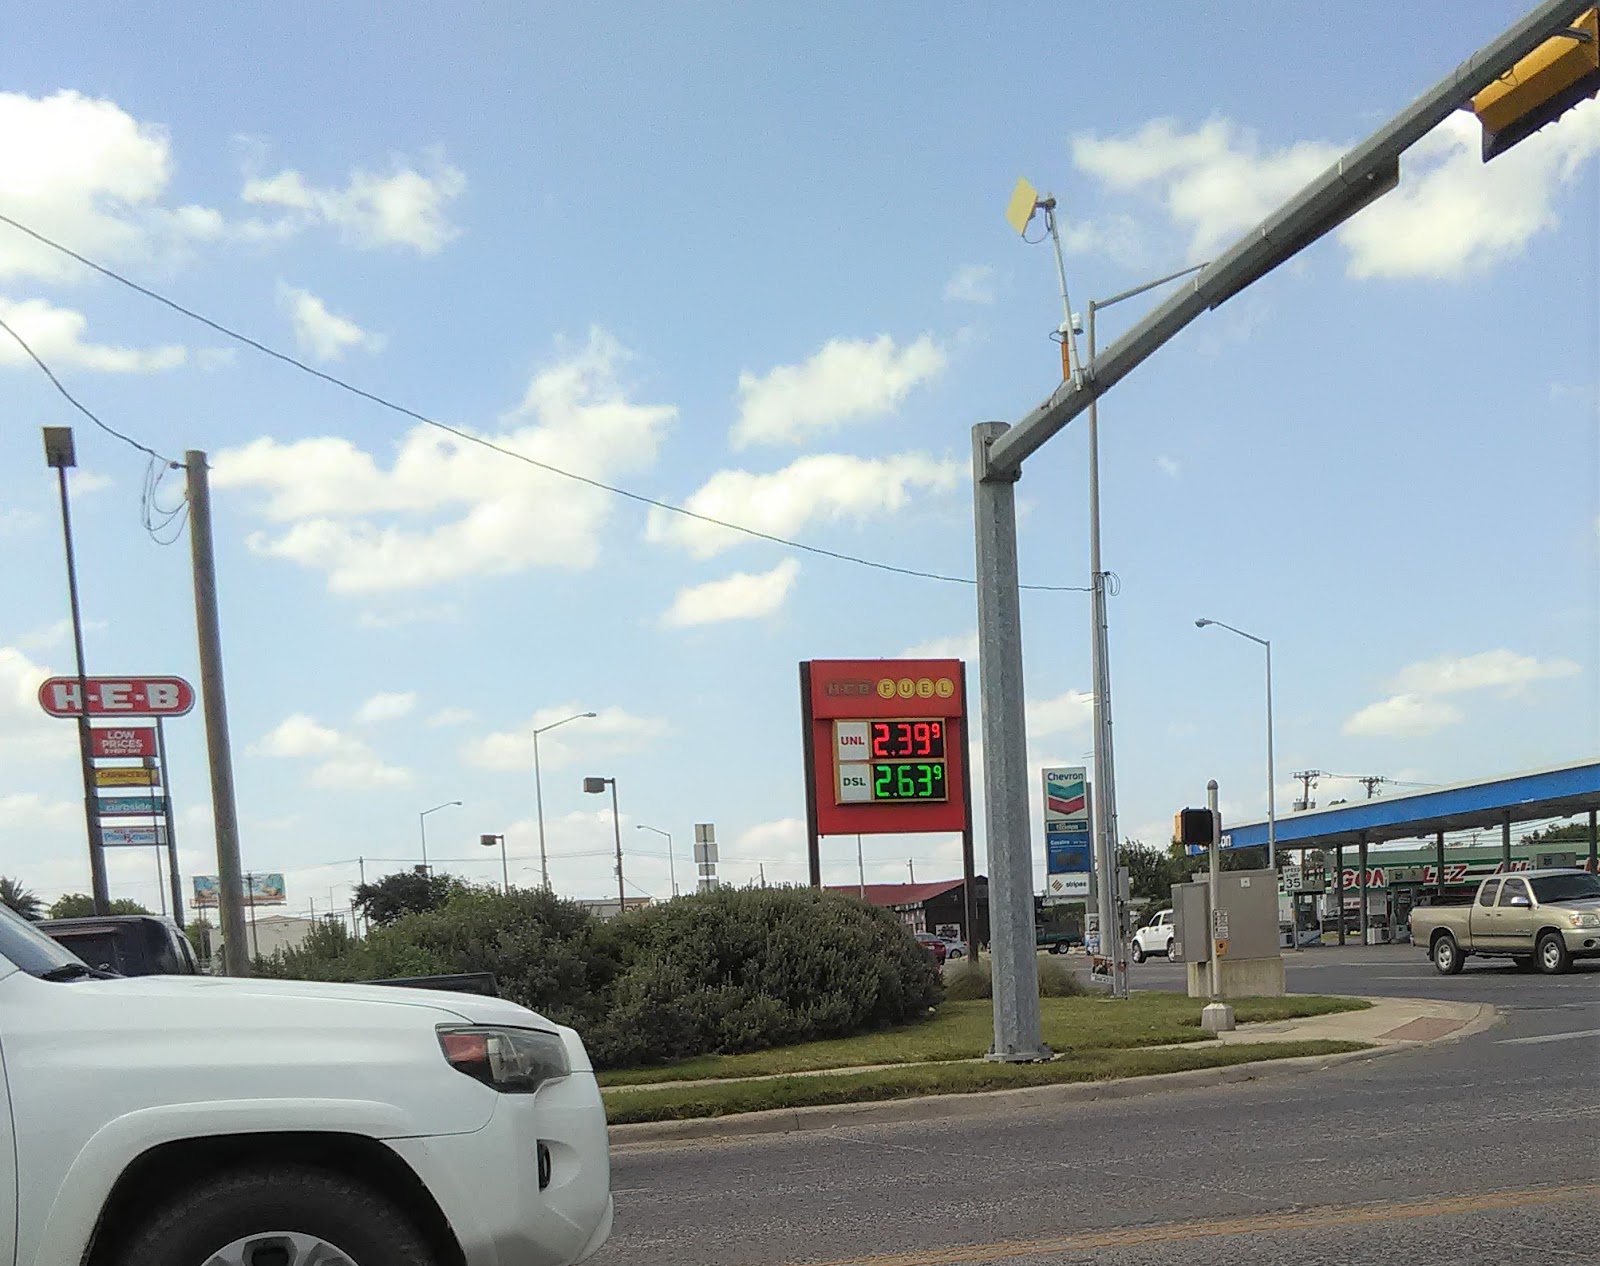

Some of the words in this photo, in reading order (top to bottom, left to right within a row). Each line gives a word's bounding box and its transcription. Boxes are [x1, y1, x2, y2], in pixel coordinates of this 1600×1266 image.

[880, 680, 951, 696] FUEL
[52, 683, 180, 709] H-E-B
[107, 731, 135, 740] LOW
[101, 739, 144, 748] PRICES
[840, 736, 865, 746] UNL
[1047, 772, 1084, 781] Chevron
[843, 777, 867, 787] DSL
[1286, 878, 1300, 888] 35
